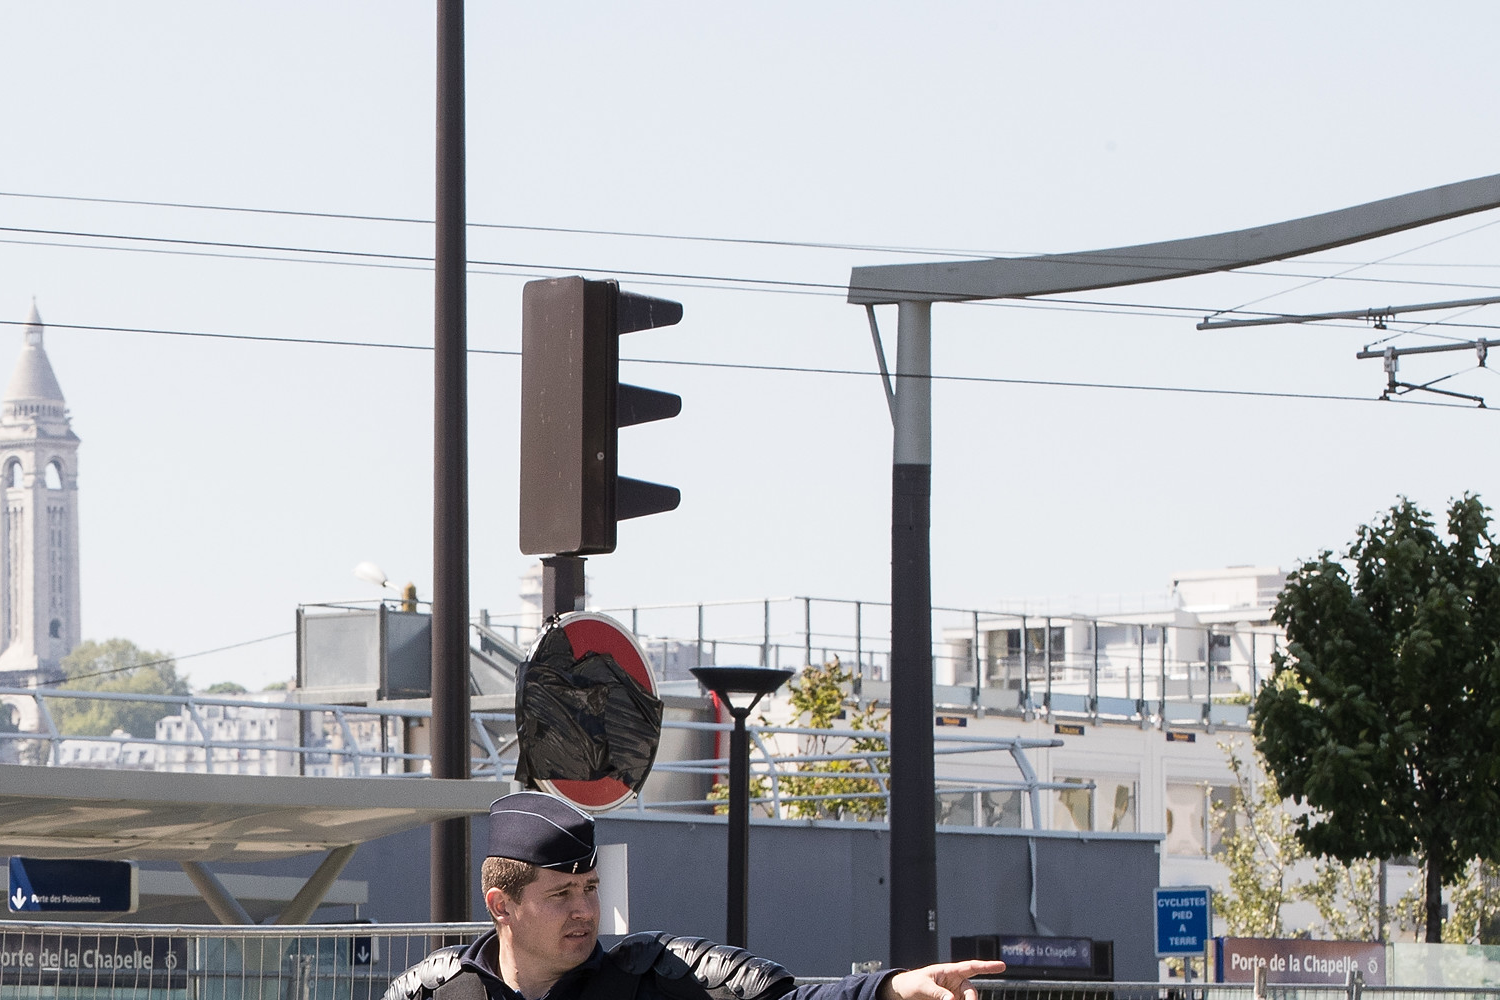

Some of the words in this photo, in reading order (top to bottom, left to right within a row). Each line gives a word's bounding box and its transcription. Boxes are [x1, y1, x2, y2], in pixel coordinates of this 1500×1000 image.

[31, 893, 49, 903] Porte
[50, 894, 61, 904] des
[62, 894, 101, 904] Poissonniers
[1158, 897, 1206, 908] CYCLISTES
[1172, 910, 1193, 920] PIED
[1179, 924, 1187, 933] A
[1169, 936, 1197, 946] TERRE
[1002, 945, 1024, 956] Porte
[1025, 945, 1035, 957] de
[1037, 945, 1043, 956] la
[1045, 946, 1077, 958] Chapelle
[40, 948, 59, 968] de
[64, 949, 79, 968] la
[83, 949, 152, 970] Chapelle
[1231, 953, 1267, 971] Porte
[1269, 954, 1285, 971] de
[1289, 954, 1300, 972] la
[1304, 955, 1359, 976] Chapelle
